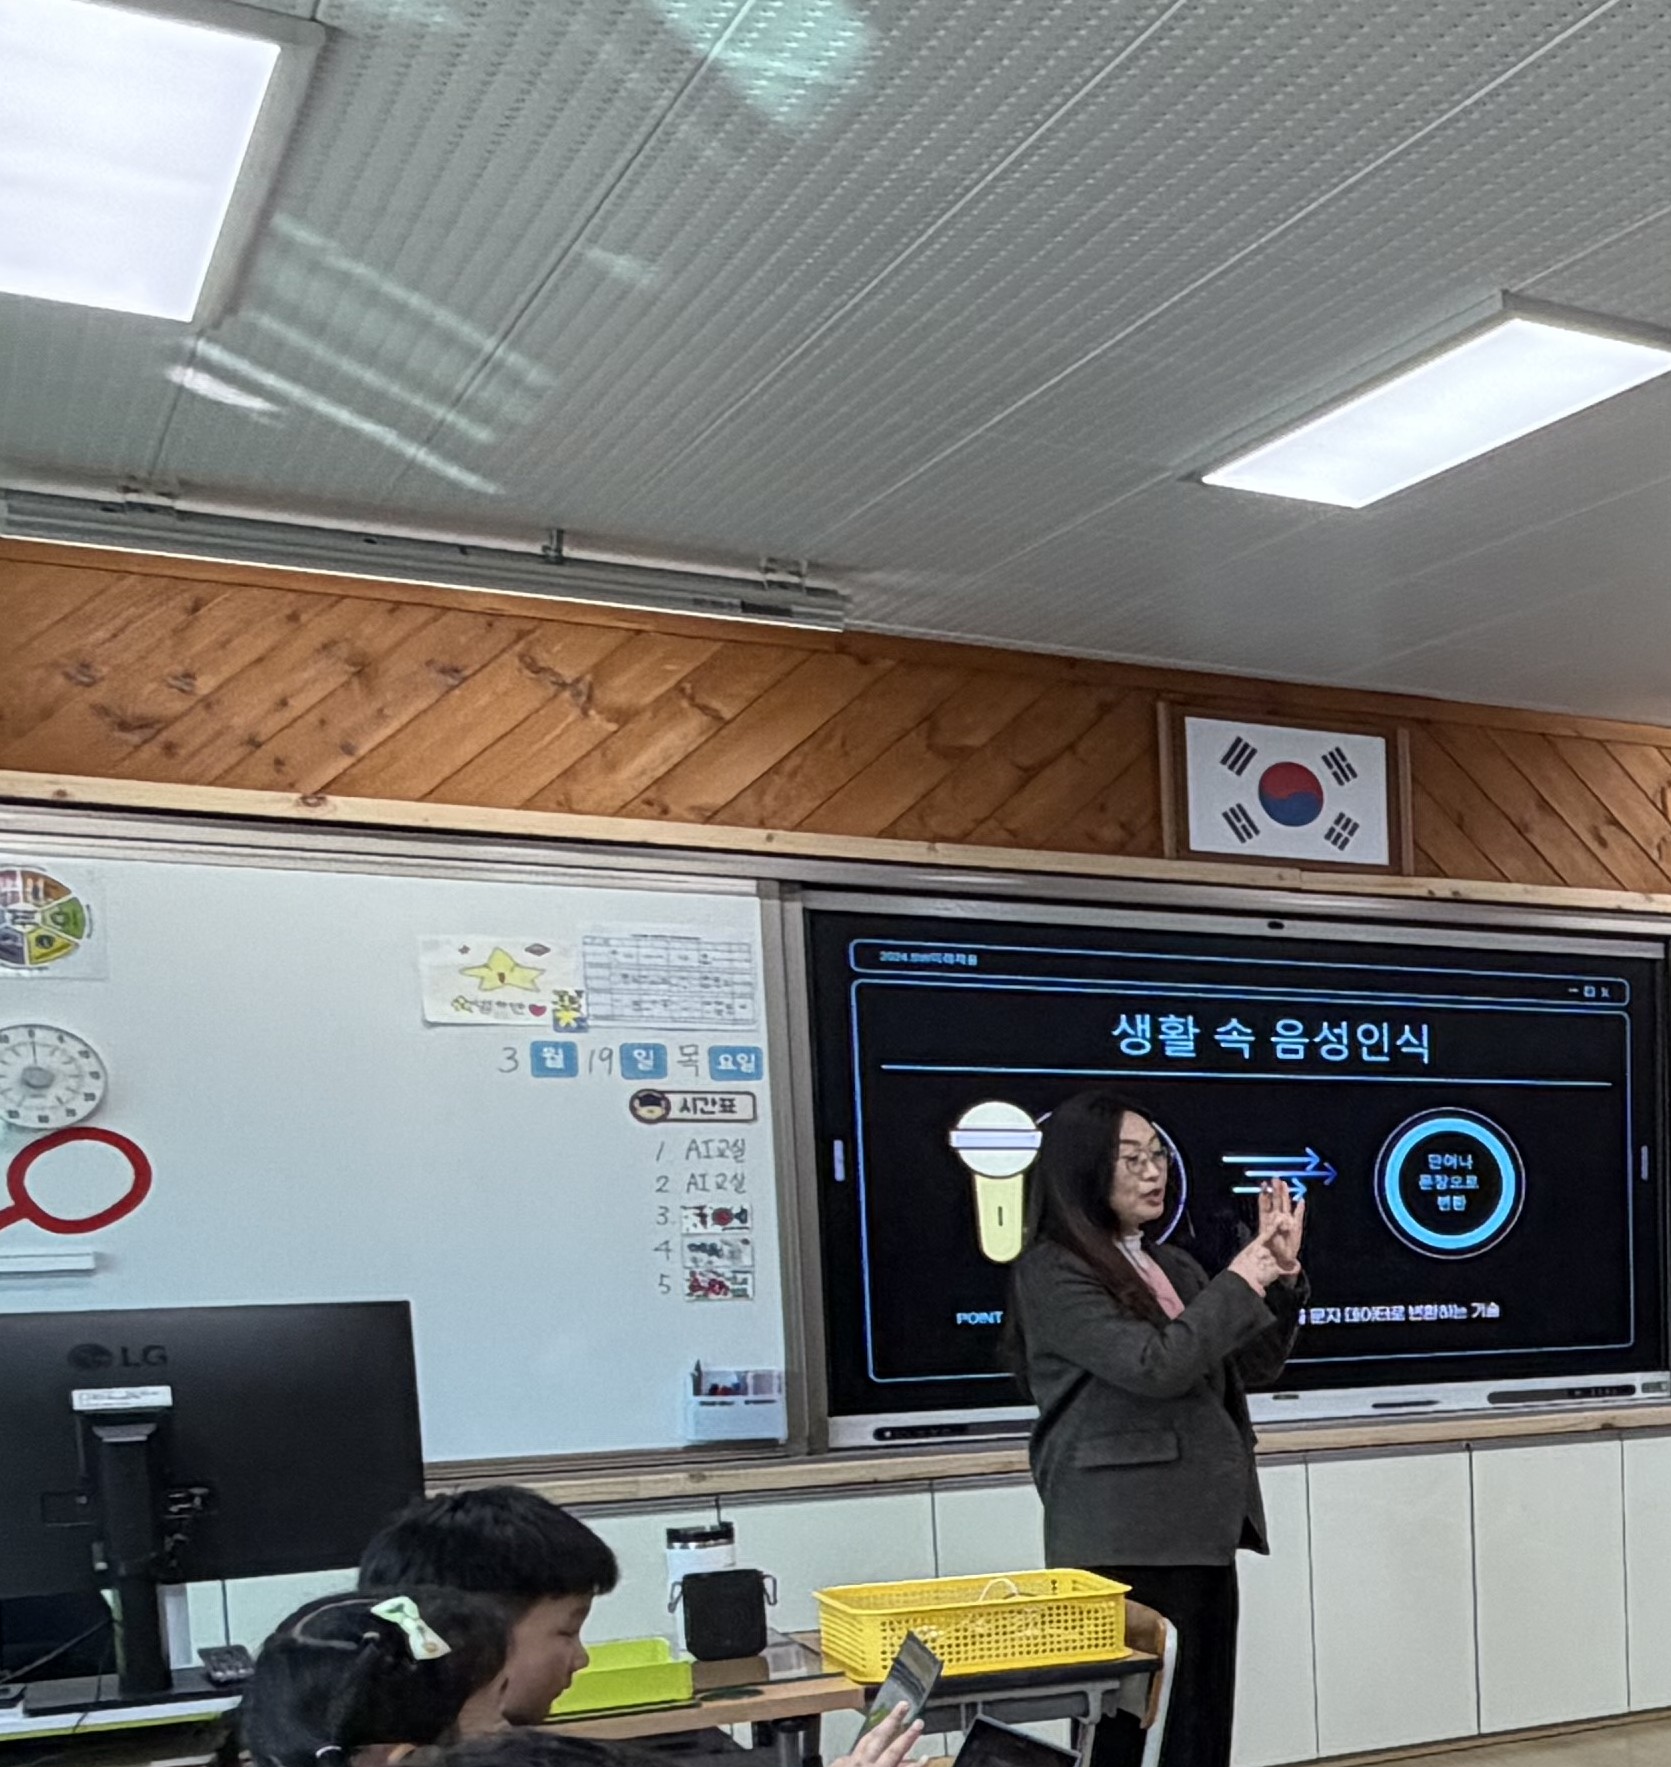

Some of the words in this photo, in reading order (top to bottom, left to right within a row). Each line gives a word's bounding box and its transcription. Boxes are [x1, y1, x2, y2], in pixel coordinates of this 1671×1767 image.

[1111, 1013, 1201, 1057] 생활
[1213, 1017, 1256, 1060] 속
[1269, 1018, 1429, 1064] 음성인식
[498, 1046, 520, 1074] 3
[541, 1046, 565, 1070] 월
[587, 1048, 614, 1075] 19
[631, 1048, 655, 1073] 일
[676, 1043, 701, 1078] 목
[716, 1052, 757, 1075] 요일
[680, 1095, 739, 1116] 시간표
[655, 1175, 670, 1194] 2
[956, 1310, 1004, 1325] POINT
[121, 1346, 168, 1368] LG
